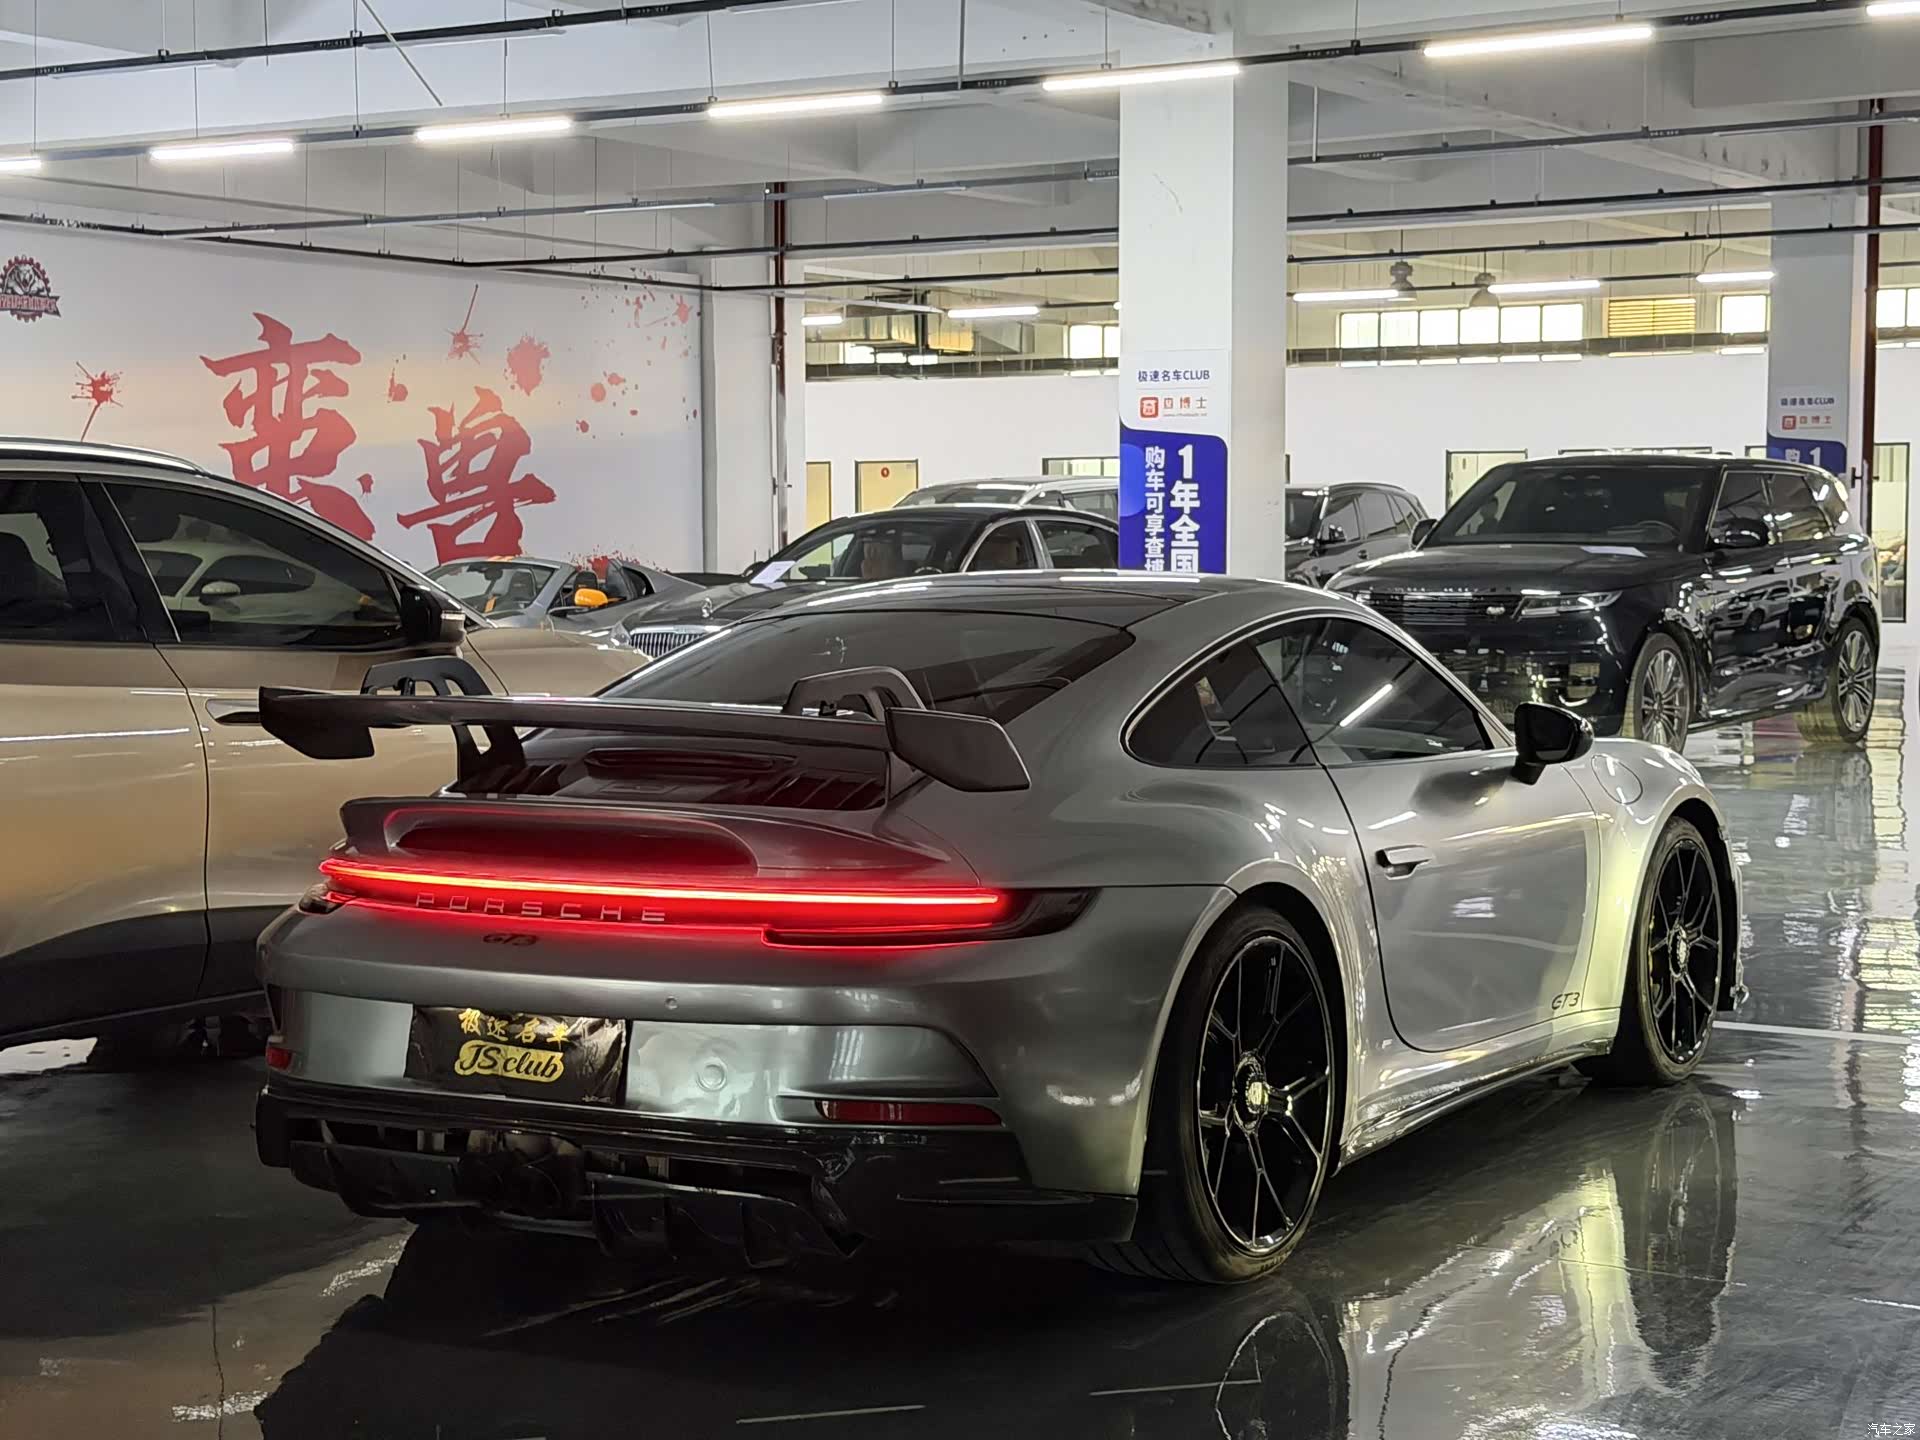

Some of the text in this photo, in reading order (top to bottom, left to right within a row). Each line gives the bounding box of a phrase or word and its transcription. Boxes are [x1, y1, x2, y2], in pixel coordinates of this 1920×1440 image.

[1169, 444, 1200, 573] 1年全国
[416, 892, 666, 922] PORSCHE
[483, 933, 539, 946] GT3
[1551, 992, 1581, 1010] GT3
